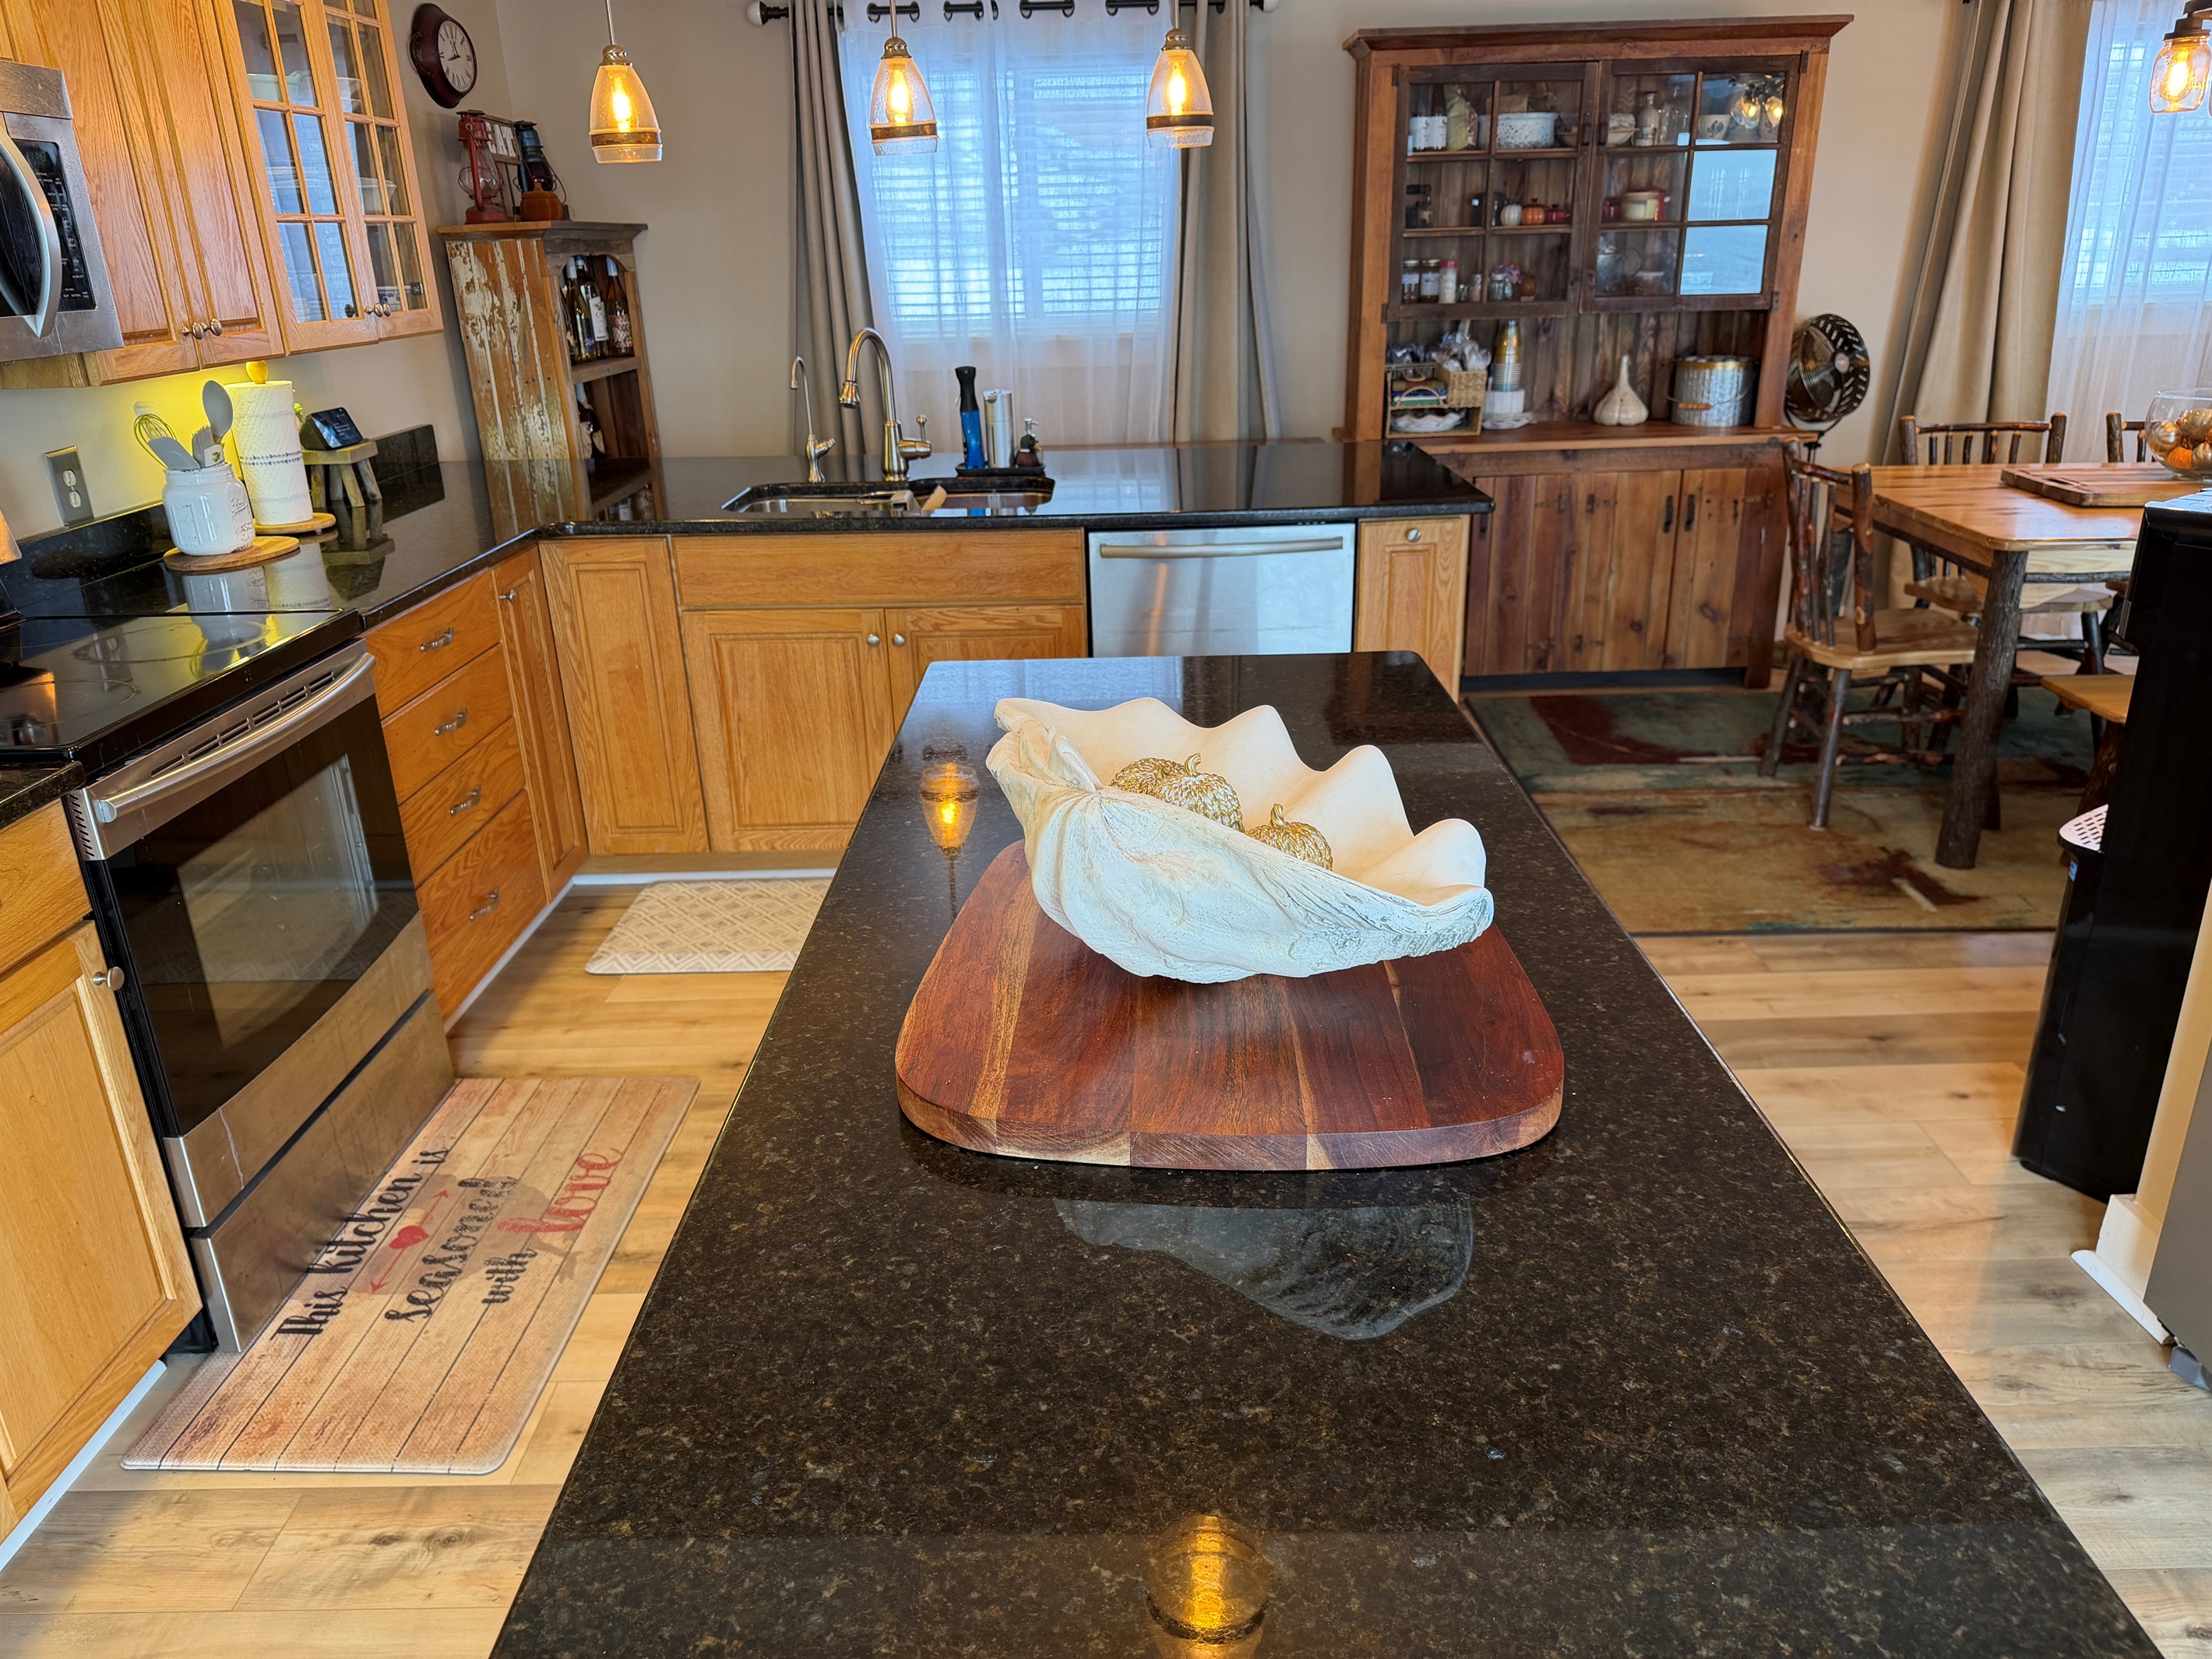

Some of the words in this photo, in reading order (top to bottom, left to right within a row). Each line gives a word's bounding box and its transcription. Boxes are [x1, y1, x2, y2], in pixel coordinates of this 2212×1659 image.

[411, 1147, 450, 1165] is
[498, 1147, 624, 1233] love
[305, 1173, 423, 1274] kitchen
[384, 1176, 519, 1323] seasoned
[481, 1248, 538, 1305] with
[269, 1287, 348, 1340] This
